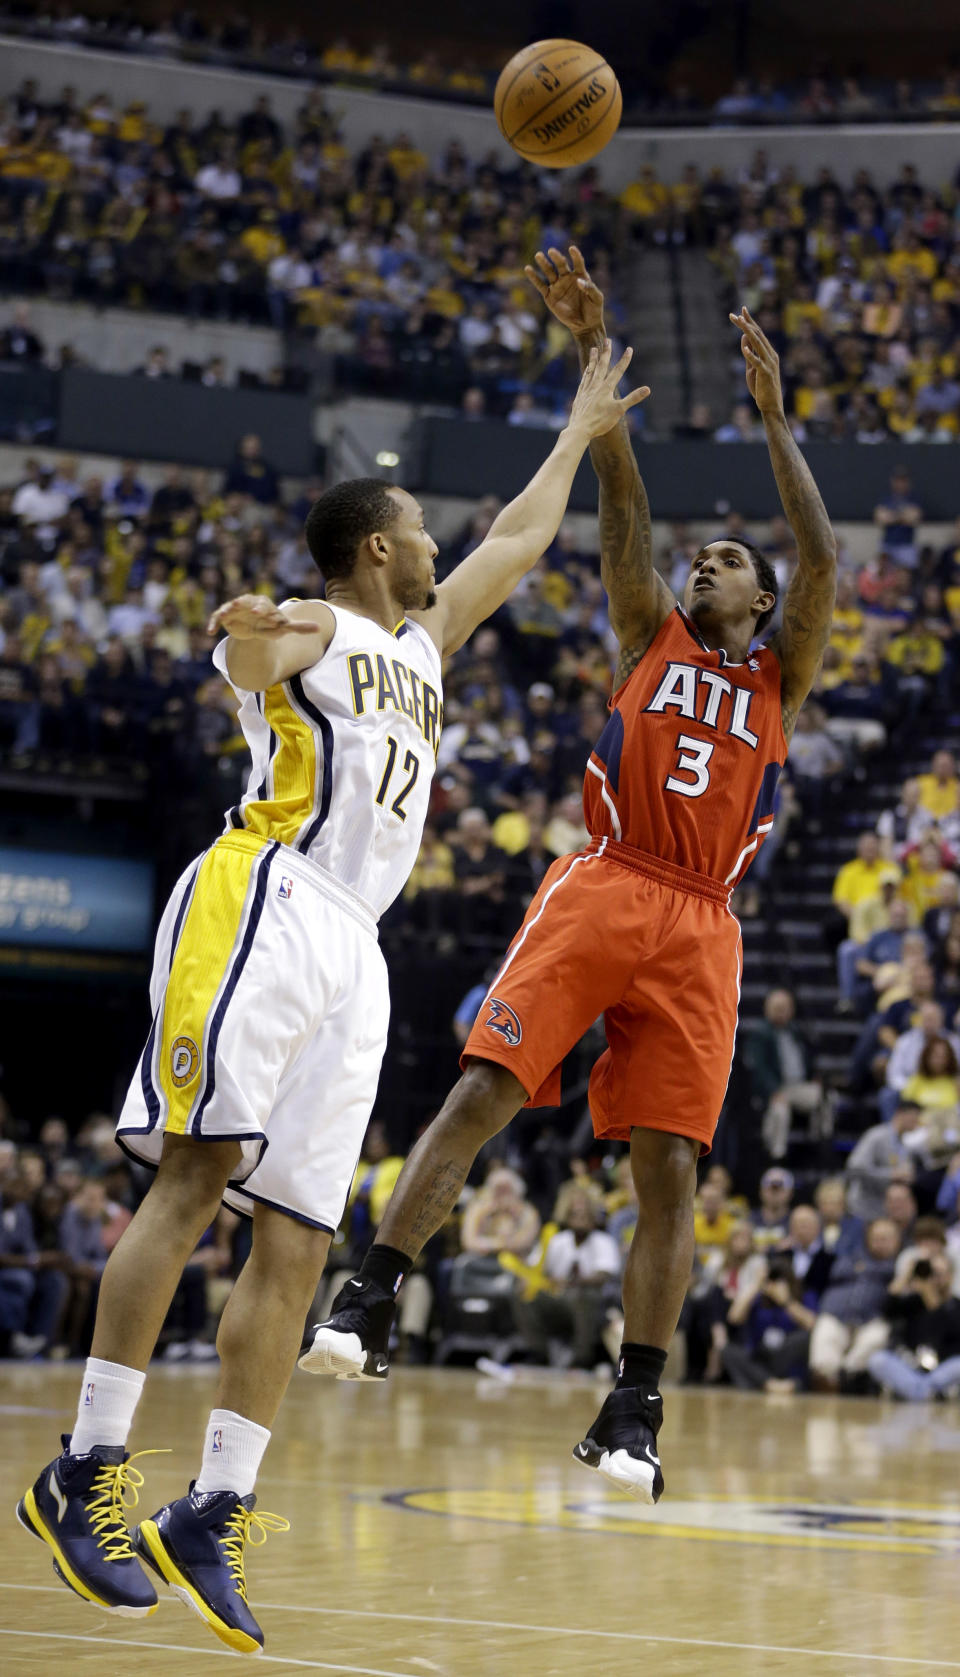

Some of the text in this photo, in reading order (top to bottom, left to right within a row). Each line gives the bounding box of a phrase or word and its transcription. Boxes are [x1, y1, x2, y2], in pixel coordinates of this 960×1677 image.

[532, 77, 606, 144] SPALDING
[640, 661, 760, 752] ATL
[376, 735, 424, 823] 12
[664, 733, 715, 798] 3
